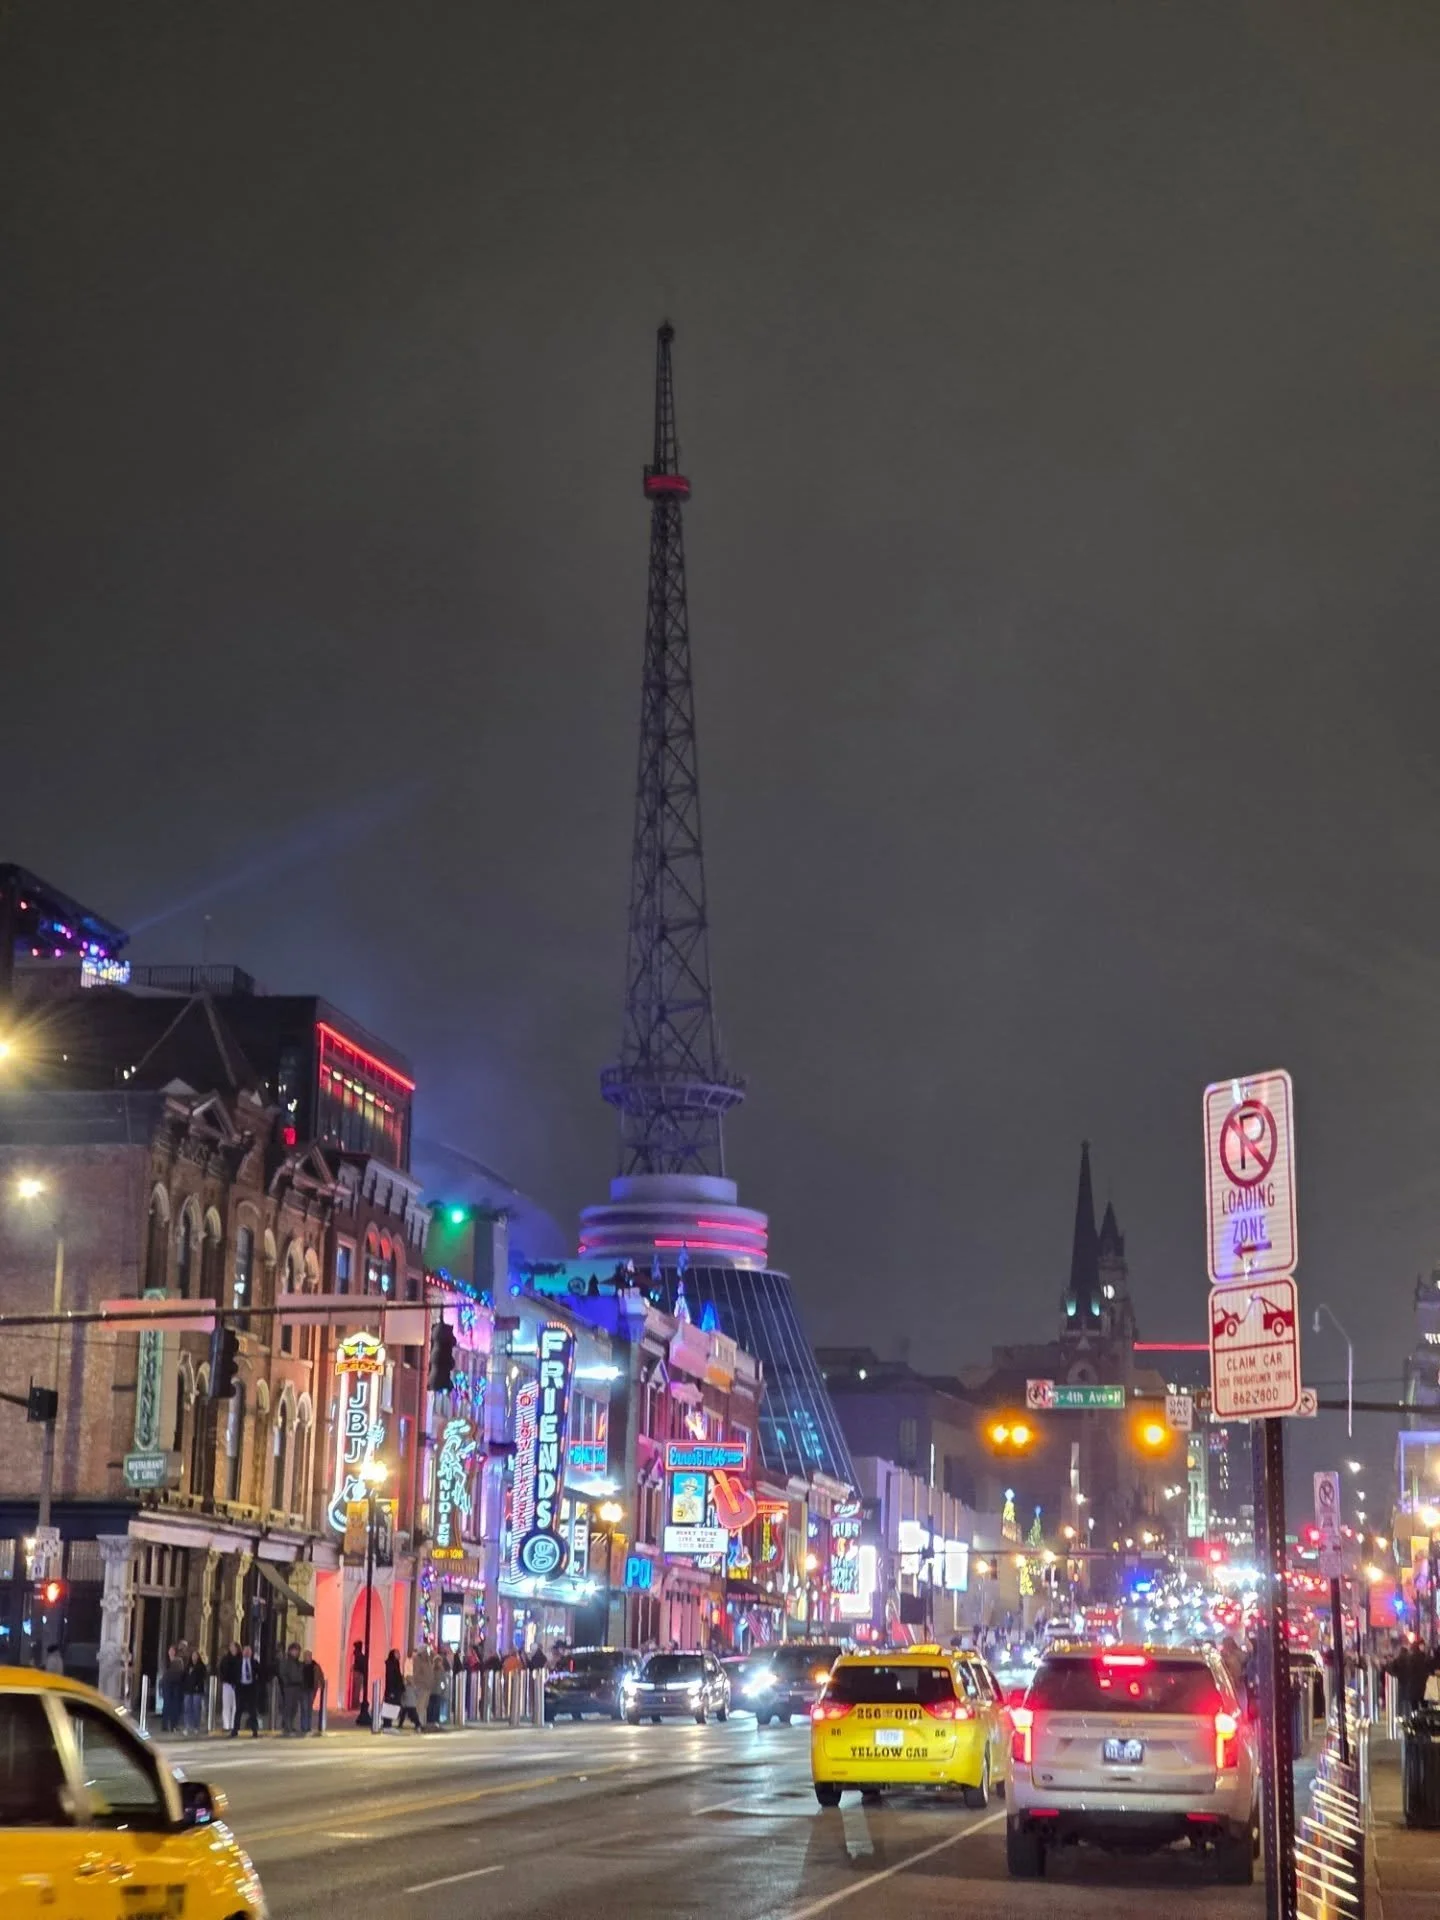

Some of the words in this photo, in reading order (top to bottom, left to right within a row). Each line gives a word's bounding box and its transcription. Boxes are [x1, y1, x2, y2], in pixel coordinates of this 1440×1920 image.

[1222, 1183, 1275, 1215] LOADING
[1232, 1215, 1266, 1244] ZONE
[1226, 1355, 1256, 1371] CLAIM
[1263, 1351, 1283, 1367] CAR
[1168, 1408, 1189, 1417] WAY
[1169, 1400, 1188, 1408] ONE
[537, 1330, 567, 1529] FRIENDS
[436, 1479, 451, 1547] NUDIES
[832, 1522, 859, 1538] RIBS
[857, 1708, 882, 1720] 256
[895, 1708, 923, 1720] 0101
[850, 1746, 903, 1757] YELLOW
[906, 1748, 928, 1757] CAB
